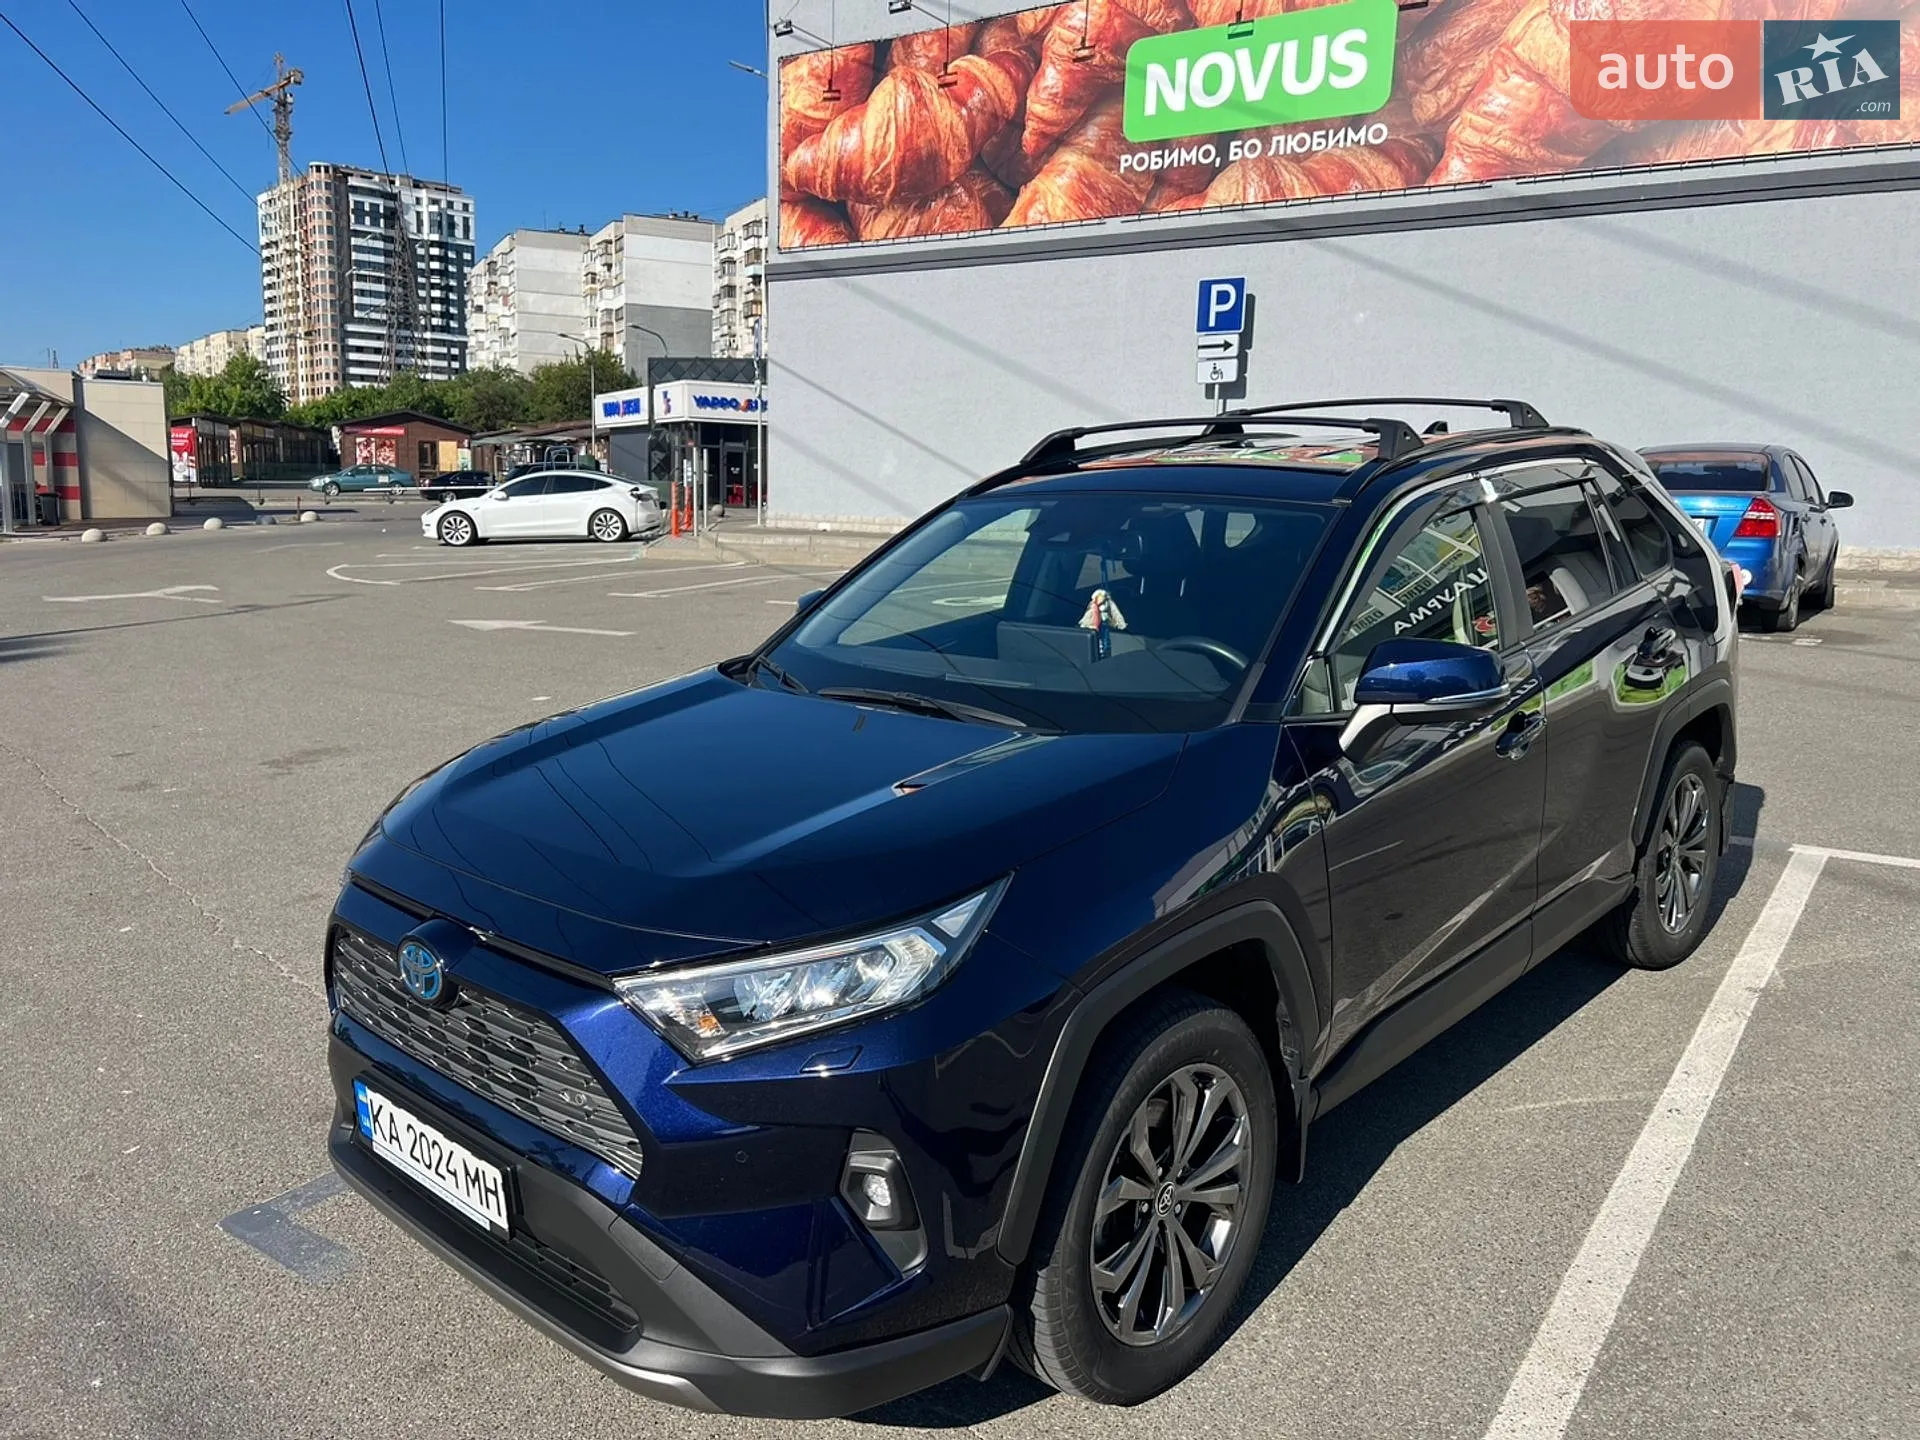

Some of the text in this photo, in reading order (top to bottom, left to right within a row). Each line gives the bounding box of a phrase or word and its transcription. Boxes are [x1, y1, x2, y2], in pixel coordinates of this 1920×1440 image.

[1143, 28, 1368, 117] NOVUS
[1119, 122, 1388, 174] РОБИМО, БО ЛЮБИМО
[1208, 283, 1237, 328] P
[406, 1123, 459, 1190] 2024
